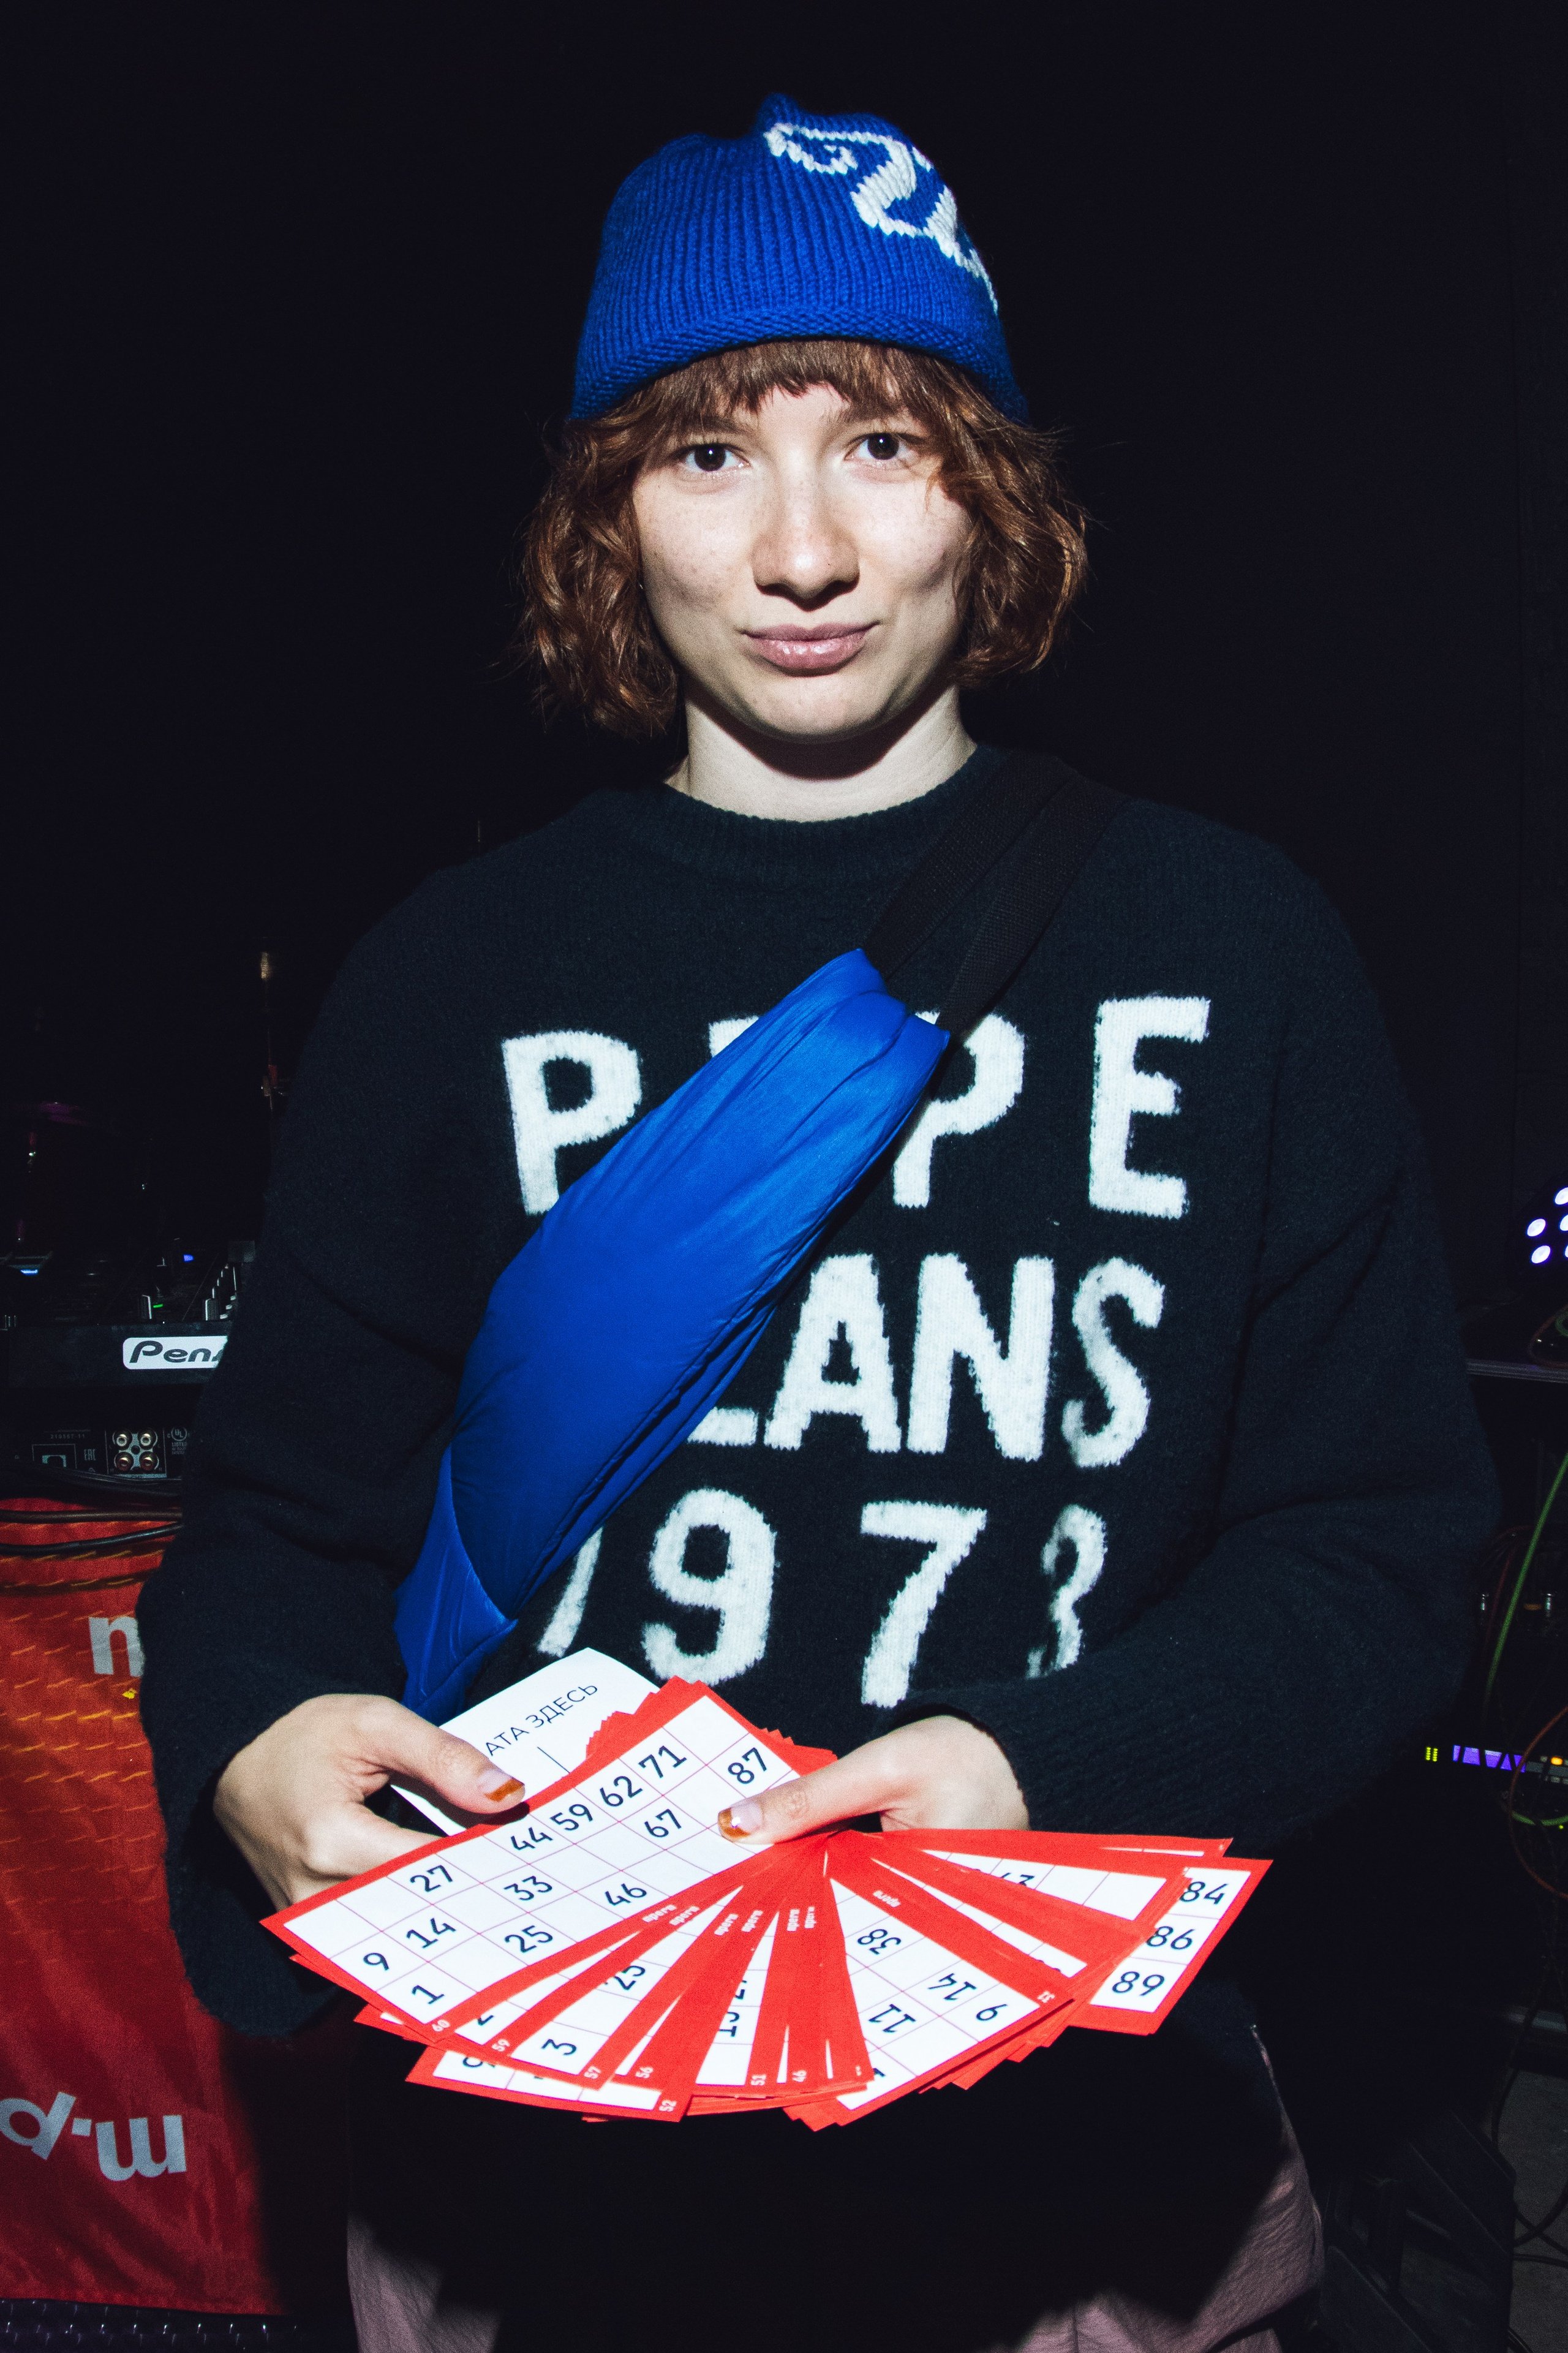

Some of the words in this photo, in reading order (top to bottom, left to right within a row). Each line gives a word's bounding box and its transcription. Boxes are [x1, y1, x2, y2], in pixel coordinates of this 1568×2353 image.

[502, 996, 1211, 1220] PPE
[526, 1685, 598, 1728] ЗДЕСЬ
[410, 1865, 453, 1893] 27
[510, 1827, 553, 1851] 44
[550, 1803, 593, 1831] 59
[600, 1776, 643, 1807] 62
[638, 1745, 687, 1778] 71
[363, 1952, 390, 1971] 9
[406, 1917, 456, 1949] 14
[503, 1876, 552, 1901] 33
[644, 1808, 682, 1838] 67
[728, 1747, 767, 1785] 87
[1179, 1881, 1228, 1905] 84
[412, 1985, 444, 2004] 1
[504, 1925, 553, 1954] 25
[605, 1883, 647, 1906] 46
[857, 1928, 902, 1955] 38
[1146, 1926, 1194, 1950] 86
[929, 1973, 976, 2001] 14
[1112, 1971, 1165, 1996] 89
[432, 2019, 451, 2033] 60
[869, 2004, 916, 2033] 11
[491, 2039, 511, 2052] 59
[541, 2039, 577, 2056] 3
[583, 2065, 602, 2080] 57
[635, 2066, 654, 2079] 56
[750, 2074, 767, 2087] 51
[658, 2099, 677, 2113] 52
